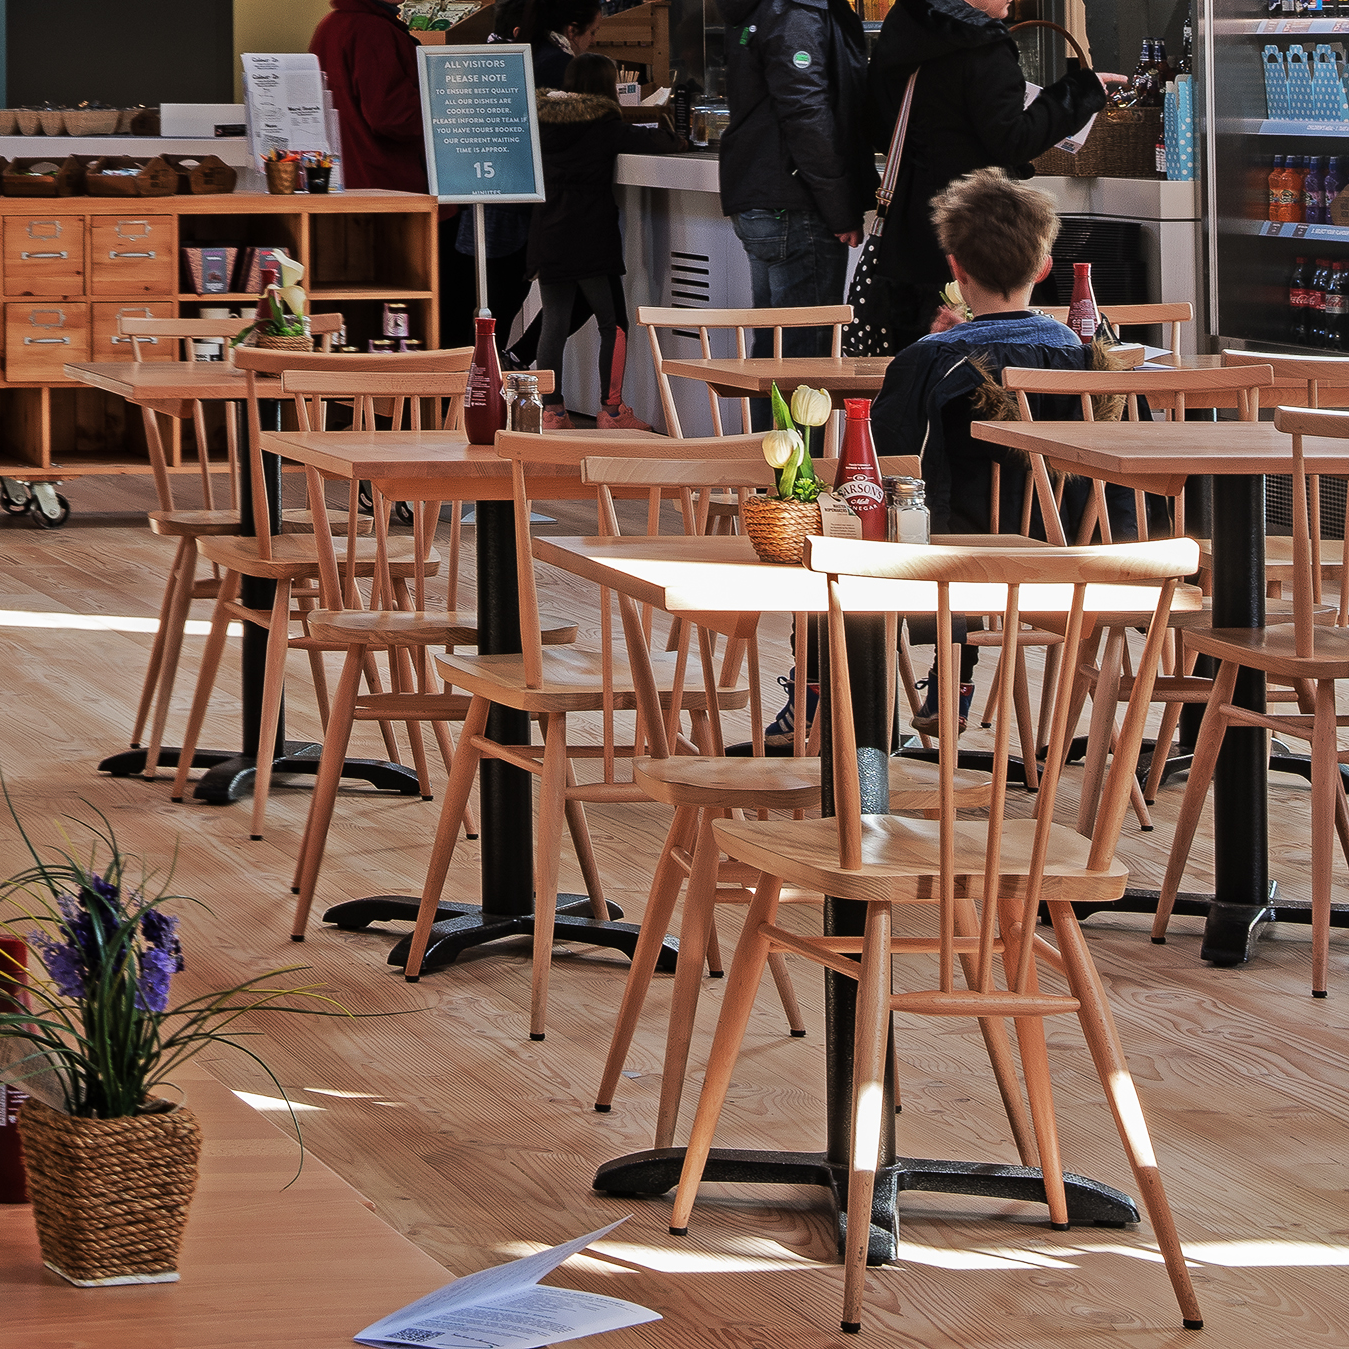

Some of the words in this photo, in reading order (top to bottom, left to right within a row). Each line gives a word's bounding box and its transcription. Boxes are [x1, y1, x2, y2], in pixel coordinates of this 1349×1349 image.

[444, 60, 461, 69] ALL
[462, 59, 506, 68] VISITORS
[445, 75, 479, 83] PLEASE
[481, 74, 507, 82] NOTE
[473, 161, 496, 179] 15
